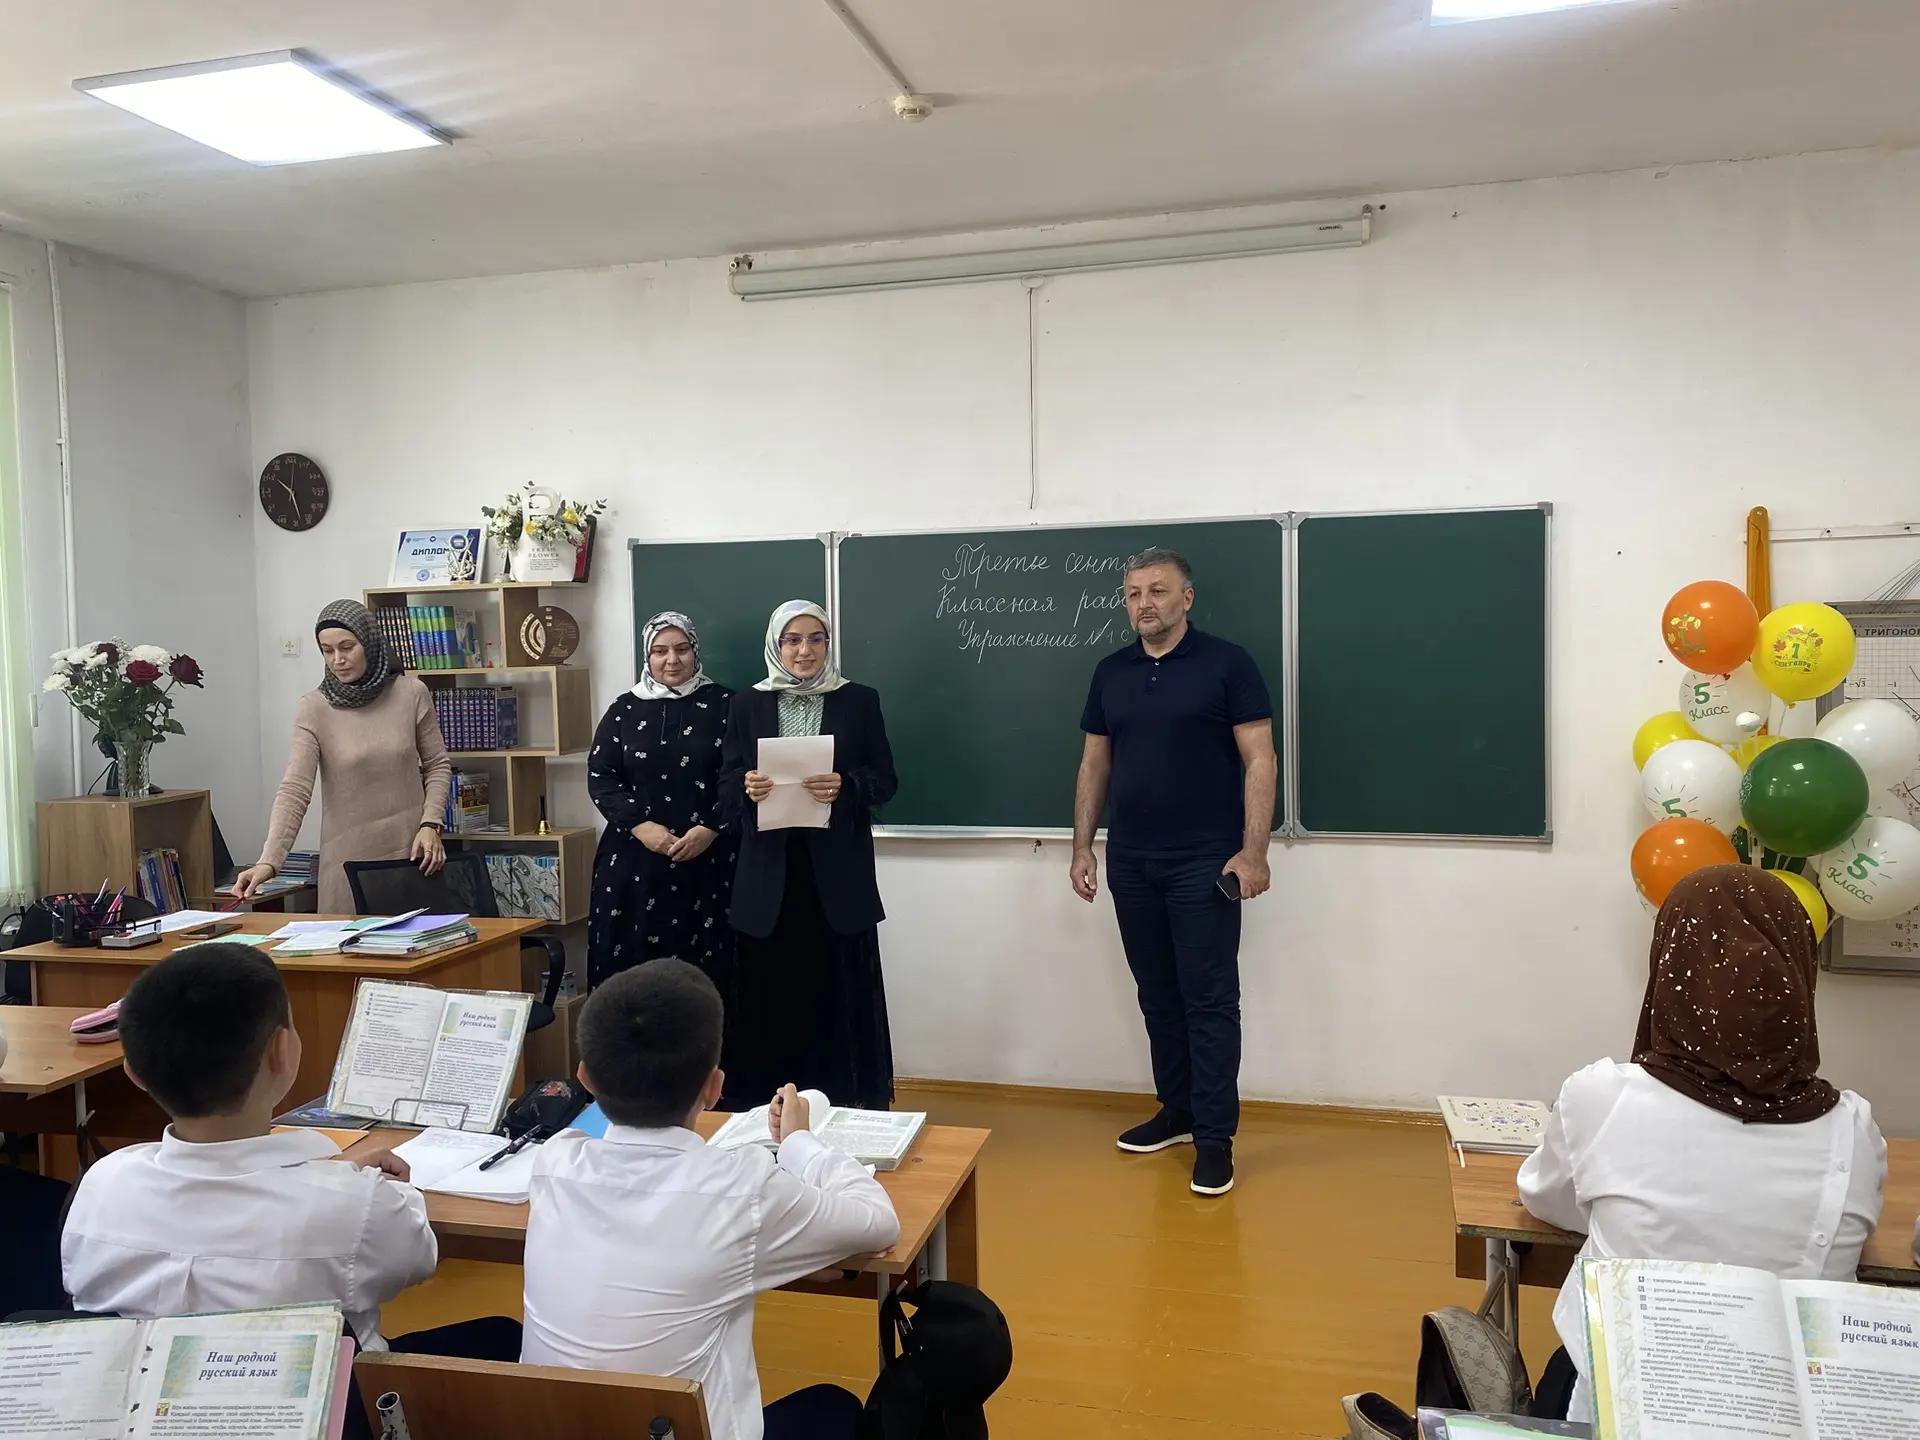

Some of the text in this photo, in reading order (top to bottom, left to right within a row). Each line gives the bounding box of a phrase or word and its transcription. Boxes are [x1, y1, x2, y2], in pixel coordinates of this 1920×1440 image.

[942, 542, 1051, 590] Третье
[936, 582, 1057, 619] Классная
[958, 618, 1079, 664] Упражнение
[1693, 682, 1711, 704] 5
[1688, 705, 1731, 722] Класс
[1846, 853, 1879, 880] 5
[1826, 866, 1874, 905] Класс
[1842, 1315, 1913, 1335] Наш родной
[1841, 1332, 1920, 1349] русский язык
[206, 1351, 278, 1366] Наш родной
[198, 1366, 278, 1381] русский язык
